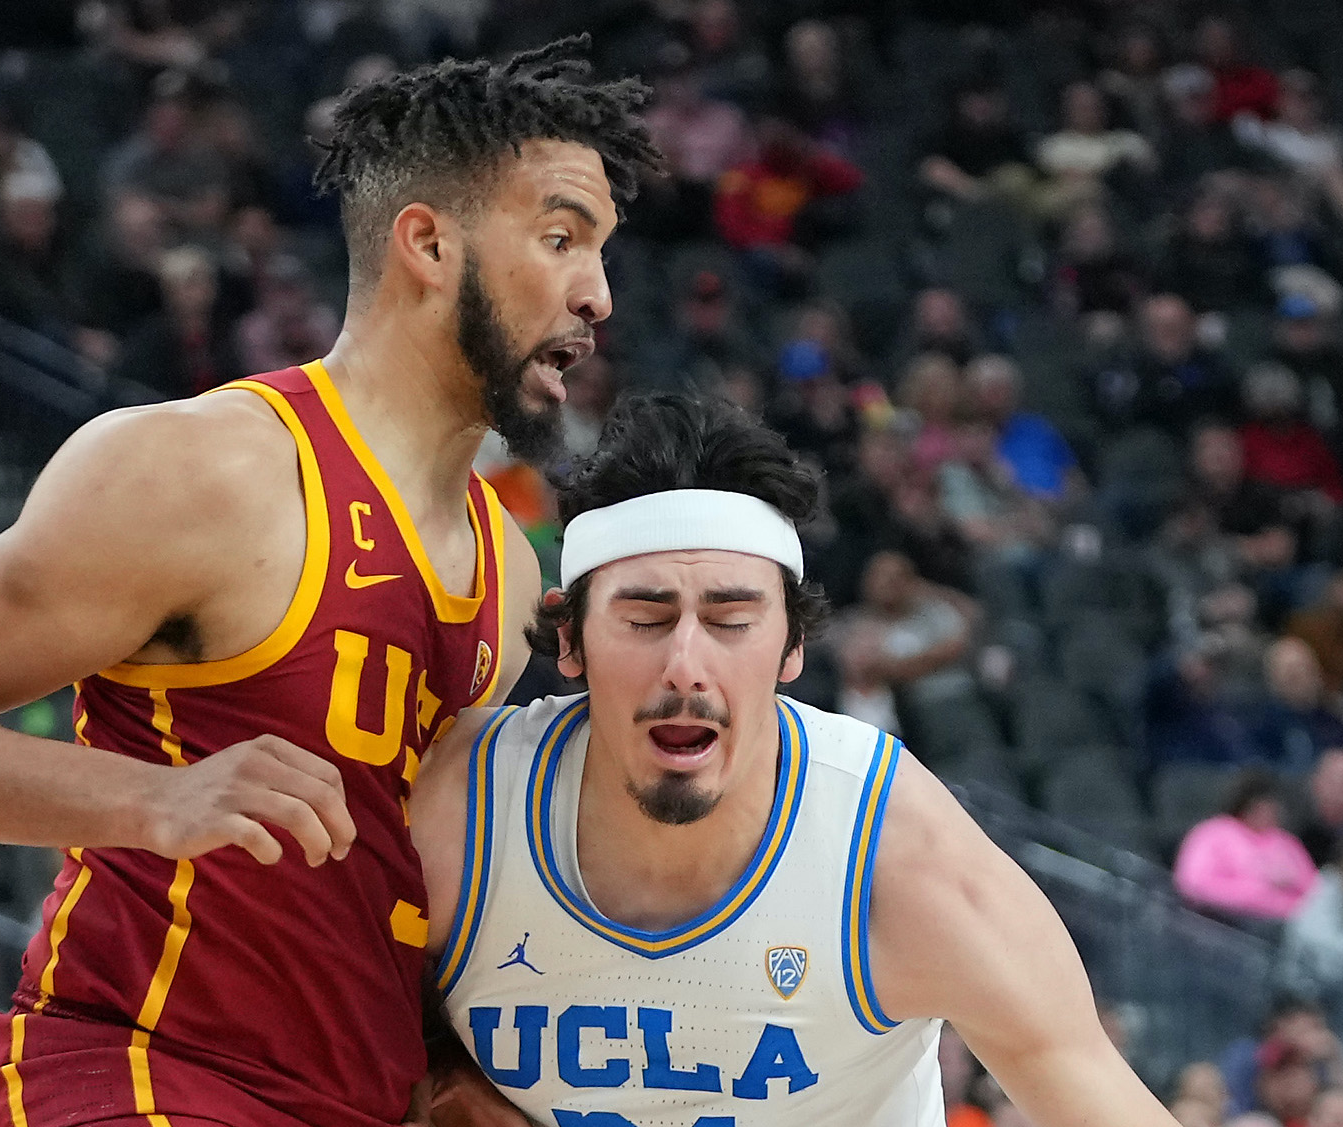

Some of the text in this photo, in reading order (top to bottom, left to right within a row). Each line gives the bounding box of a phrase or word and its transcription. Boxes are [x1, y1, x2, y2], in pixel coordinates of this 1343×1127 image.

[349, 501, 375, 551] C
[768, 948, 806, 978] PAC
[777, 968, 796, 988] 12
[469, 1004, 819, 1100] UCLA
